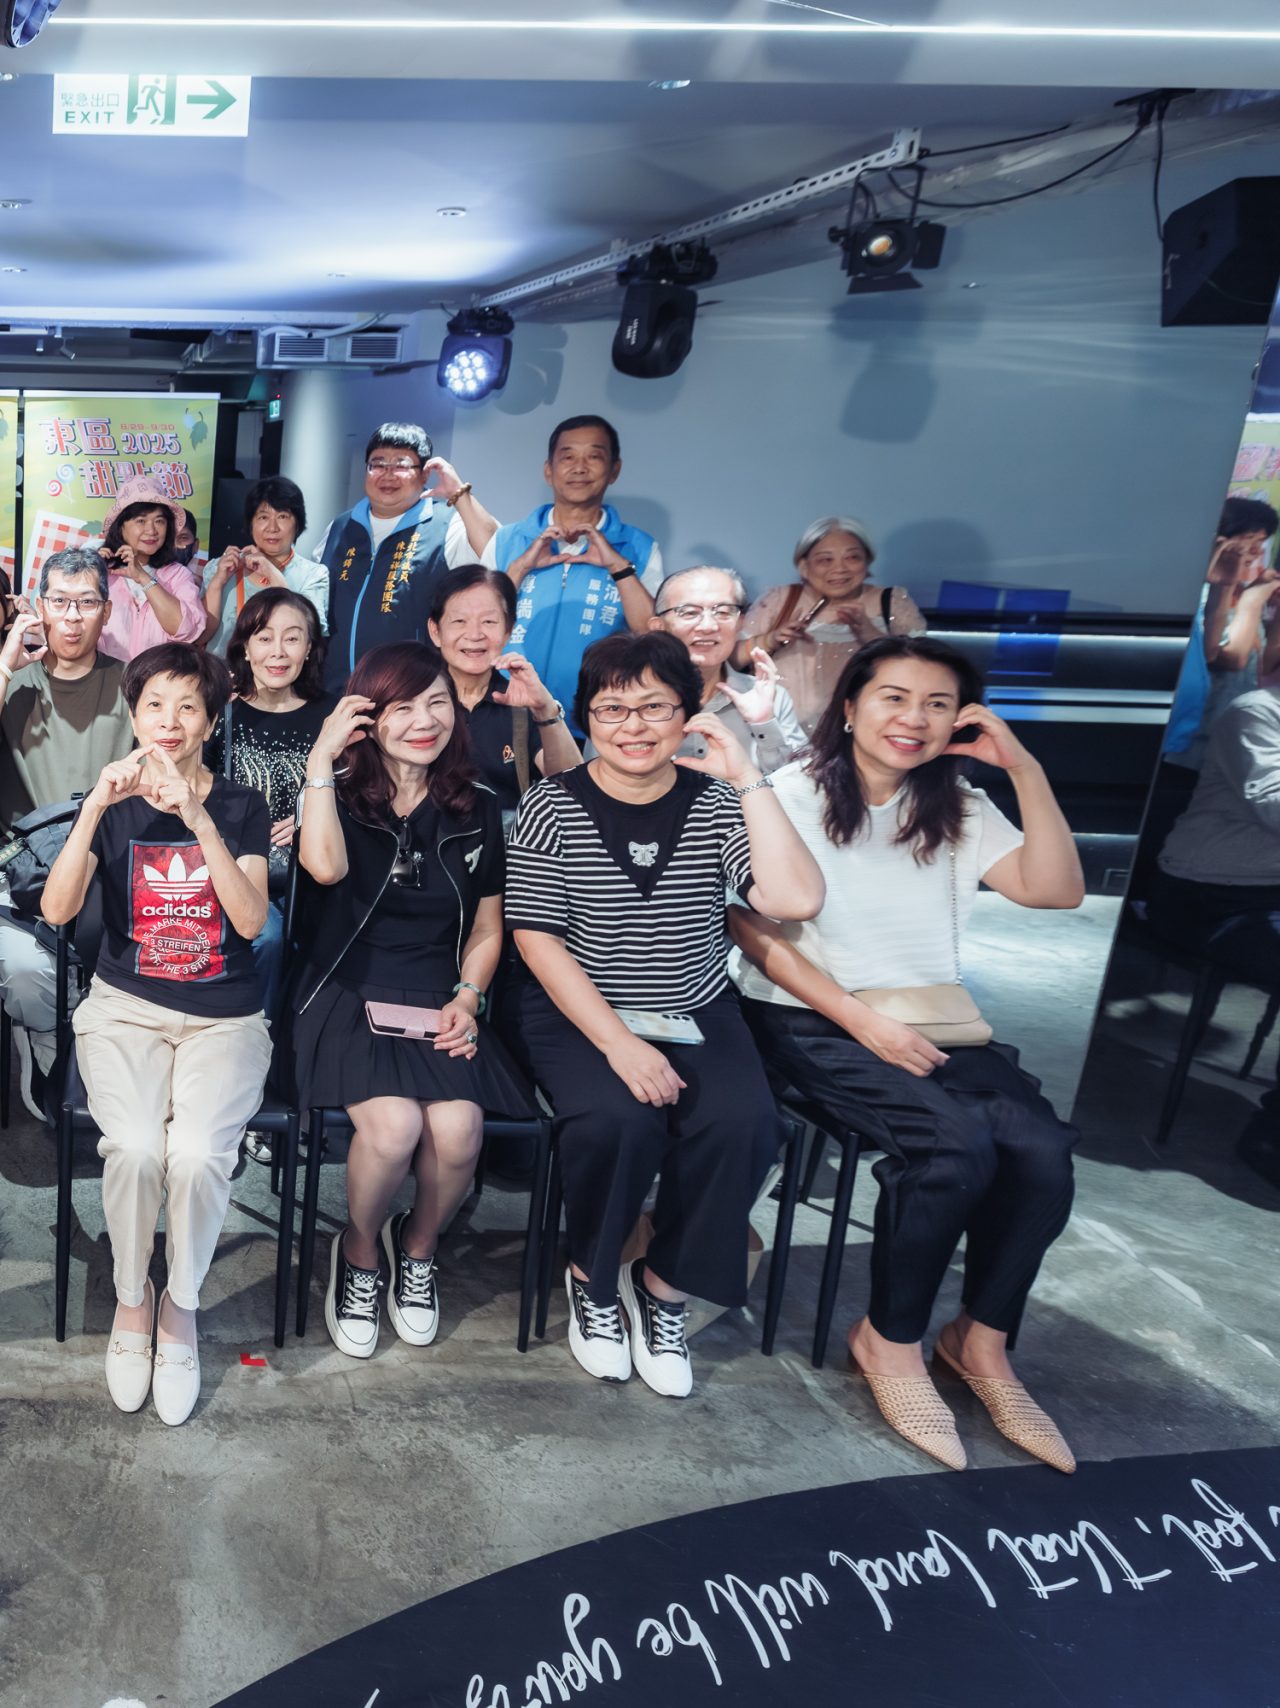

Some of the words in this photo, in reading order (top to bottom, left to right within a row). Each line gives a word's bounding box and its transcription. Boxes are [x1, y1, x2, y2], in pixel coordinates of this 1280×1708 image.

[61, 92, 120, 108] 緊急出口
[65, 111, 114, 124] EXIT
[38, 417, 120, 456] 東區
[120, 432, 182, 455] 2025
[600, 575, 621, 626] 沛君
[142, 903, 212, 919] adidas
[149, 917, 183, 933] MARKE
[184, 918, 202, 932] MIT
[157, 939, 201, 953] STREIFEN
[162, 963, 181, 975] THE
[182, 966, 189, 975] 3
[988, 1521, 1172, 1599] that
[829, 1530, 996, 1631] land
[705, 1573, 829, 1668] will
[637, 1603, 722, 1685] be
